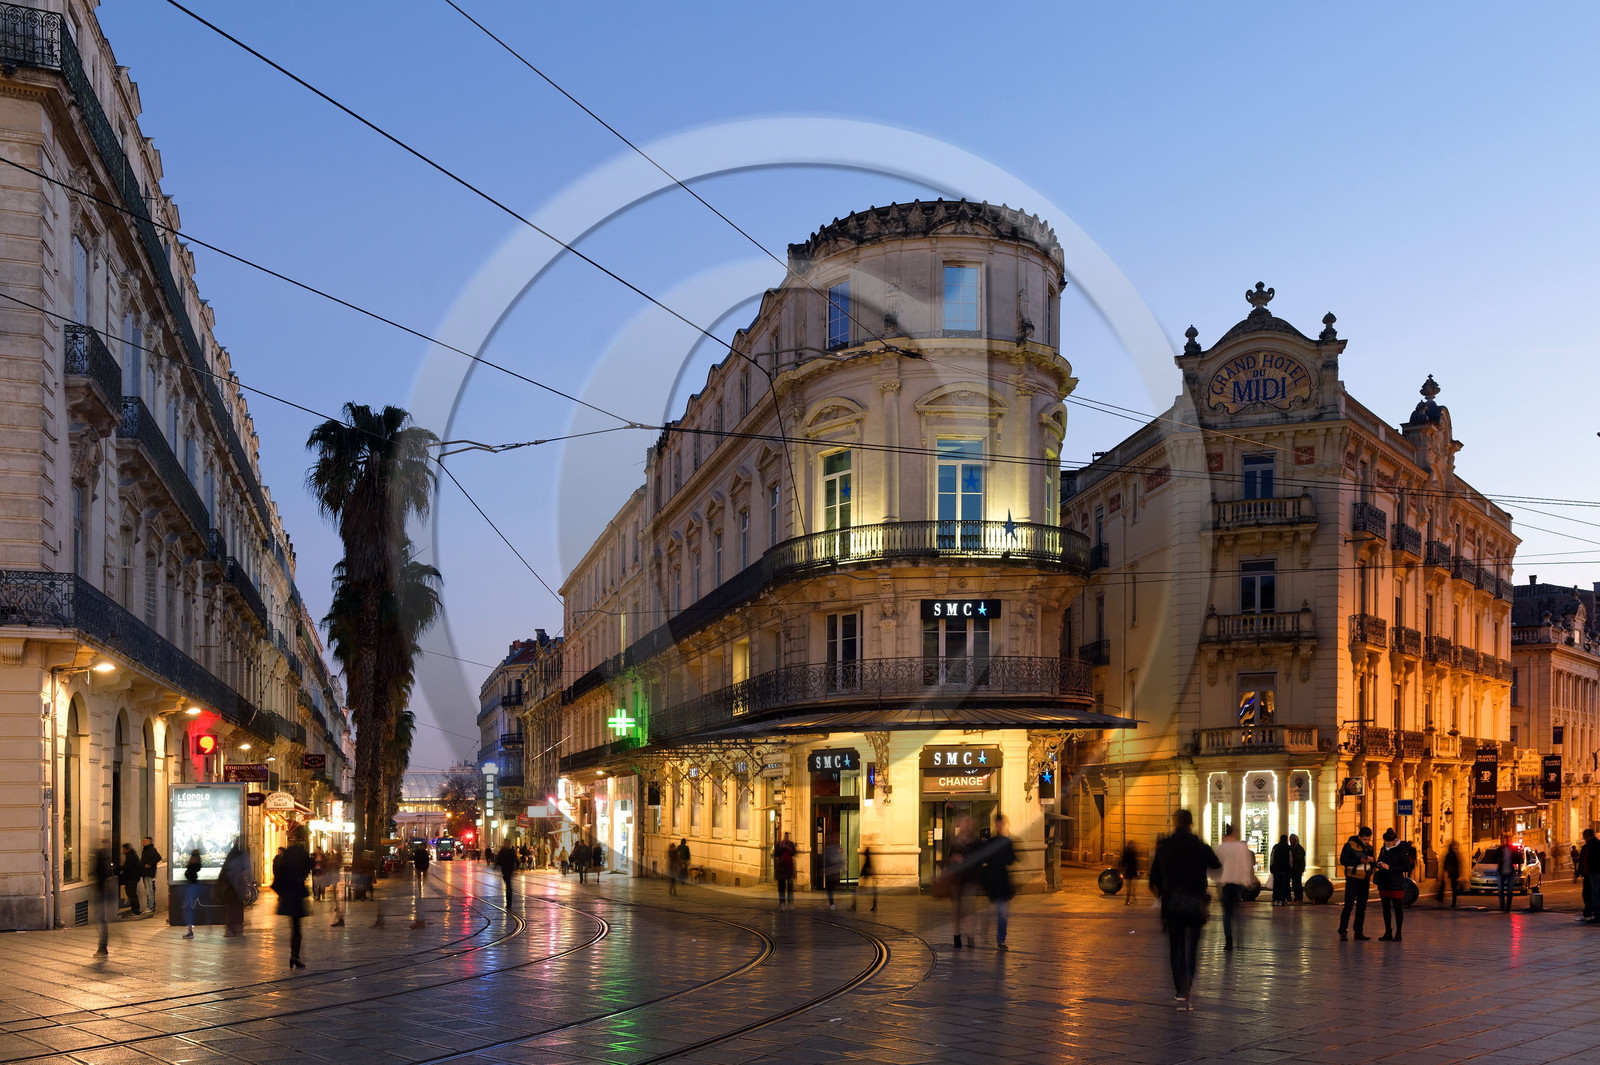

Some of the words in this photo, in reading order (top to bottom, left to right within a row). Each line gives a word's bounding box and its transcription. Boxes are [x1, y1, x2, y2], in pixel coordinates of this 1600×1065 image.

[1211, 355, 1257, 396] GRAND
[1262, 354, 1307, 387] HOTEL
[1253, 369, 1266, 378] DU
[1232, 376, 1287, 403] MIDI
[938, 777, 983, 787] CHANGE
[177, 792, 210, 801] LÉOPOLD
